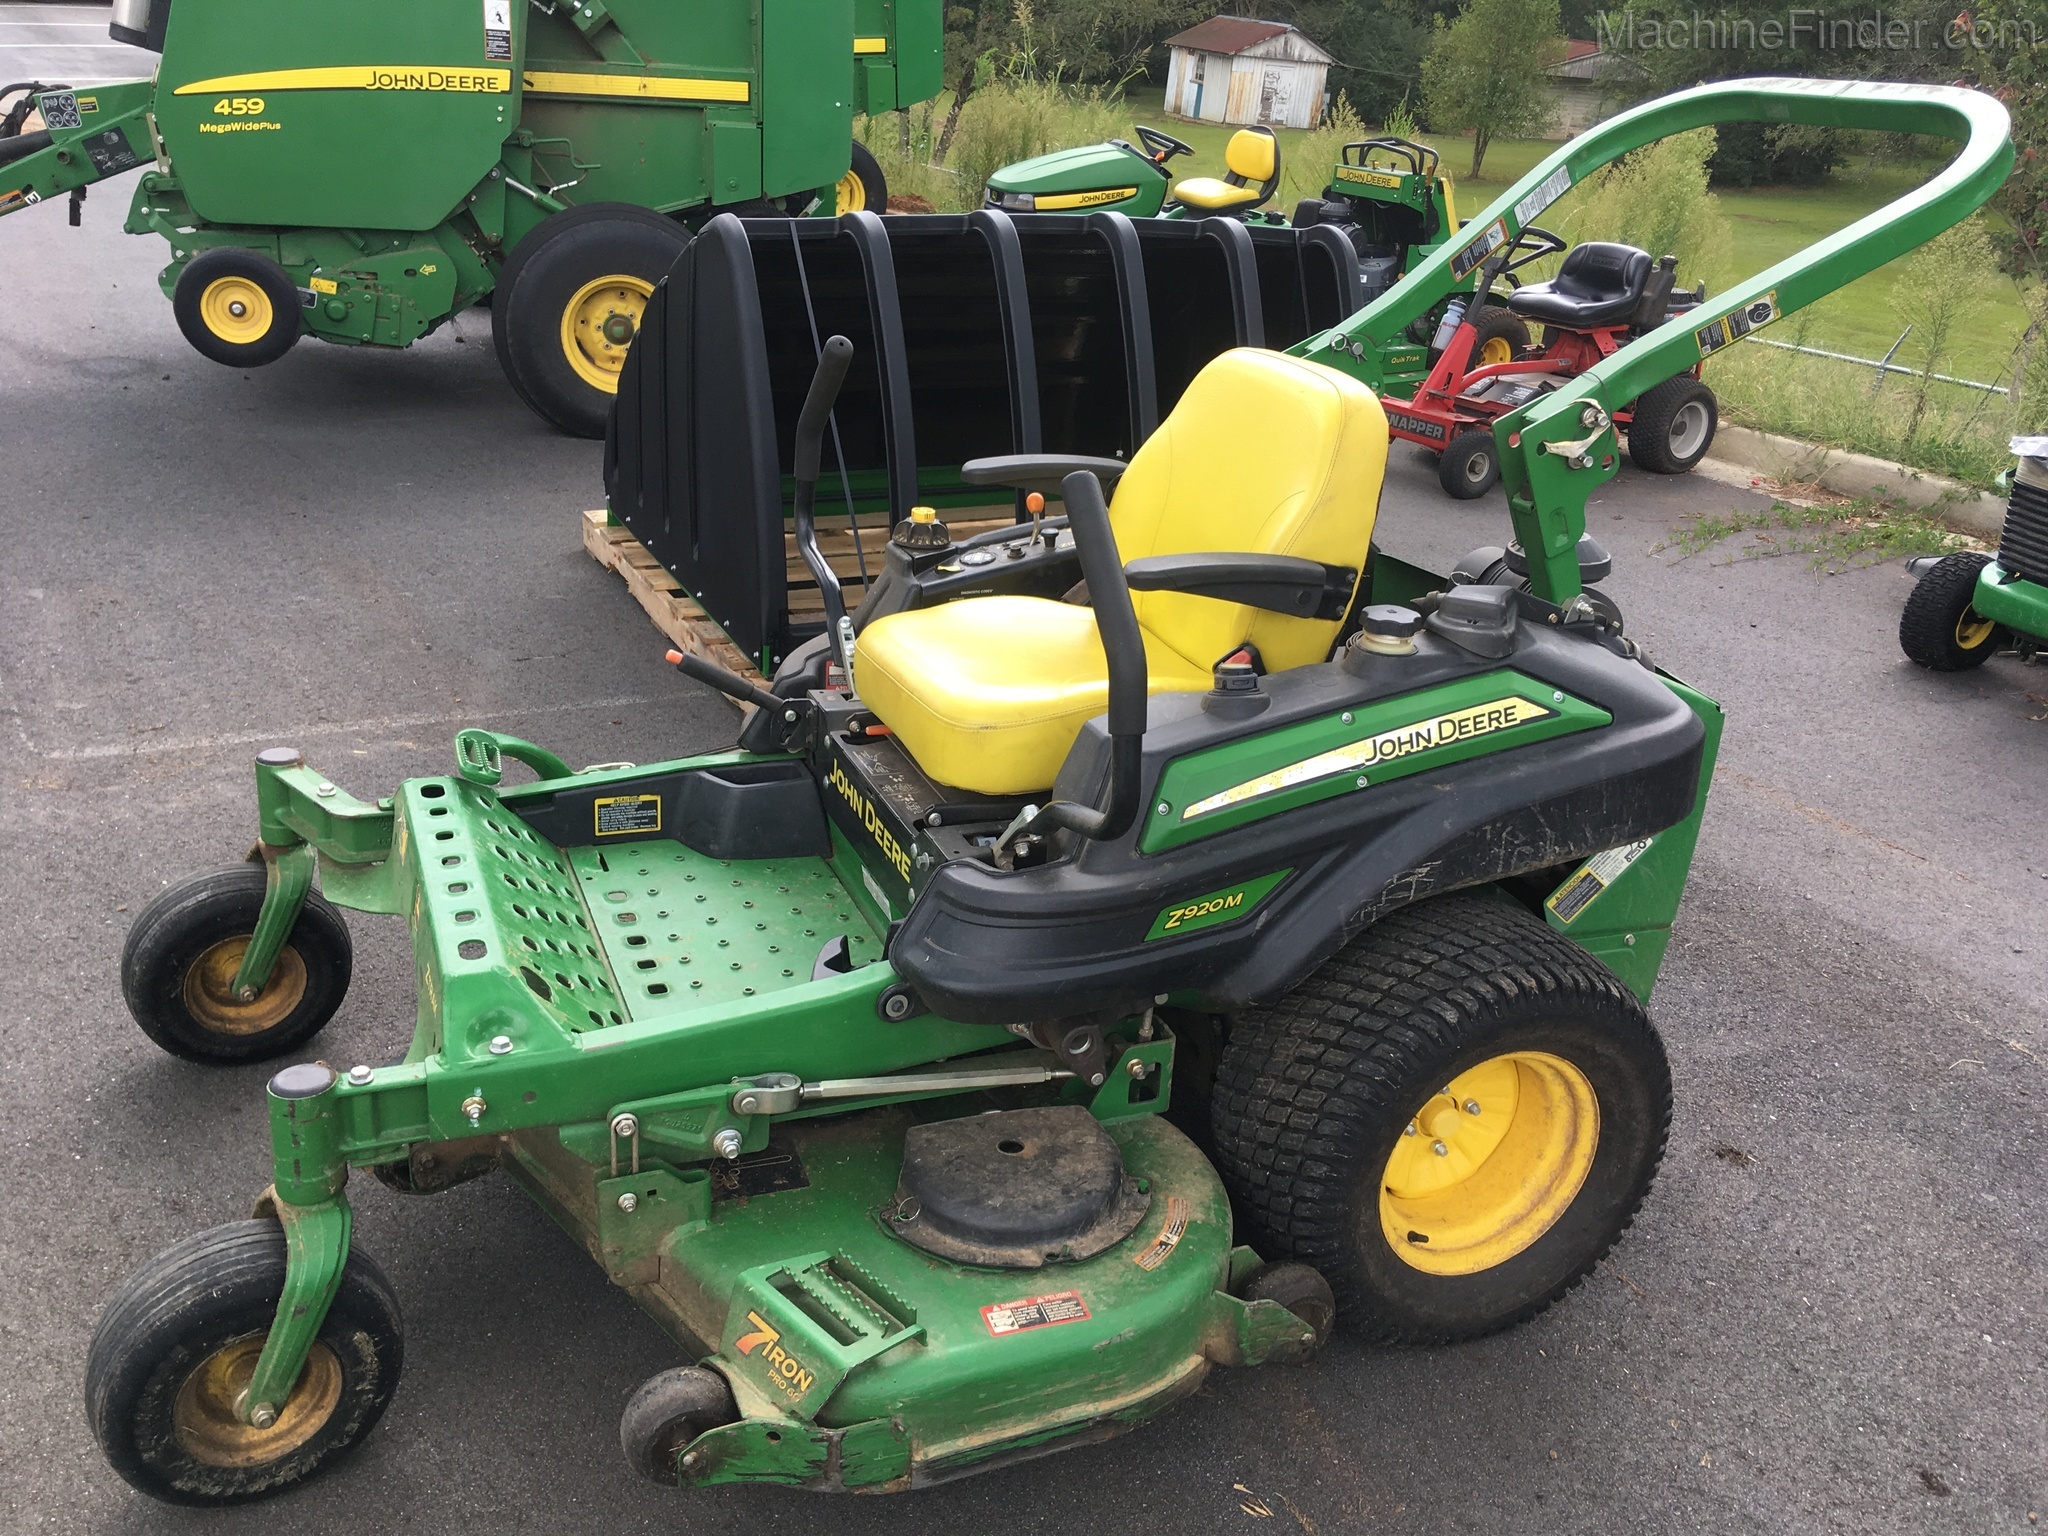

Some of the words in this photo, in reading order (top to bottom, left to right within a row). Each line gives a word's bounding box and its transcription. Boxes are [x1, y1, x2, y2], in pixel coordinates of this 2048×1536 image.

[366, 71, 424, 87] JOHN
[428, 72, 499, 90] DEERE
[213, 97, 265, 116] 459
[199, 121, 281, 134] MegaWidePlus
[1343, 170, 1366, 183] JOHN
[1366, 173, 1392, 187] DEERE
[1079, 194, 1100, 204] JOHN
[1101, 191, 1126, 201] DEERE
[1365, 728, 1432, 763] JOHN
[1438, 705, 1518, 741] DEERE
[829, 758, 863, 820] JOHN
[865, 799, 911, 884] DEERE
[1164, 892, 1244, 929] Z920M
[1001, 1300, 1028, 1310] DANGER
[1045, 1292, 1072, 1301] PELIGRO
[767, 1369, 787, 1390] PRO
